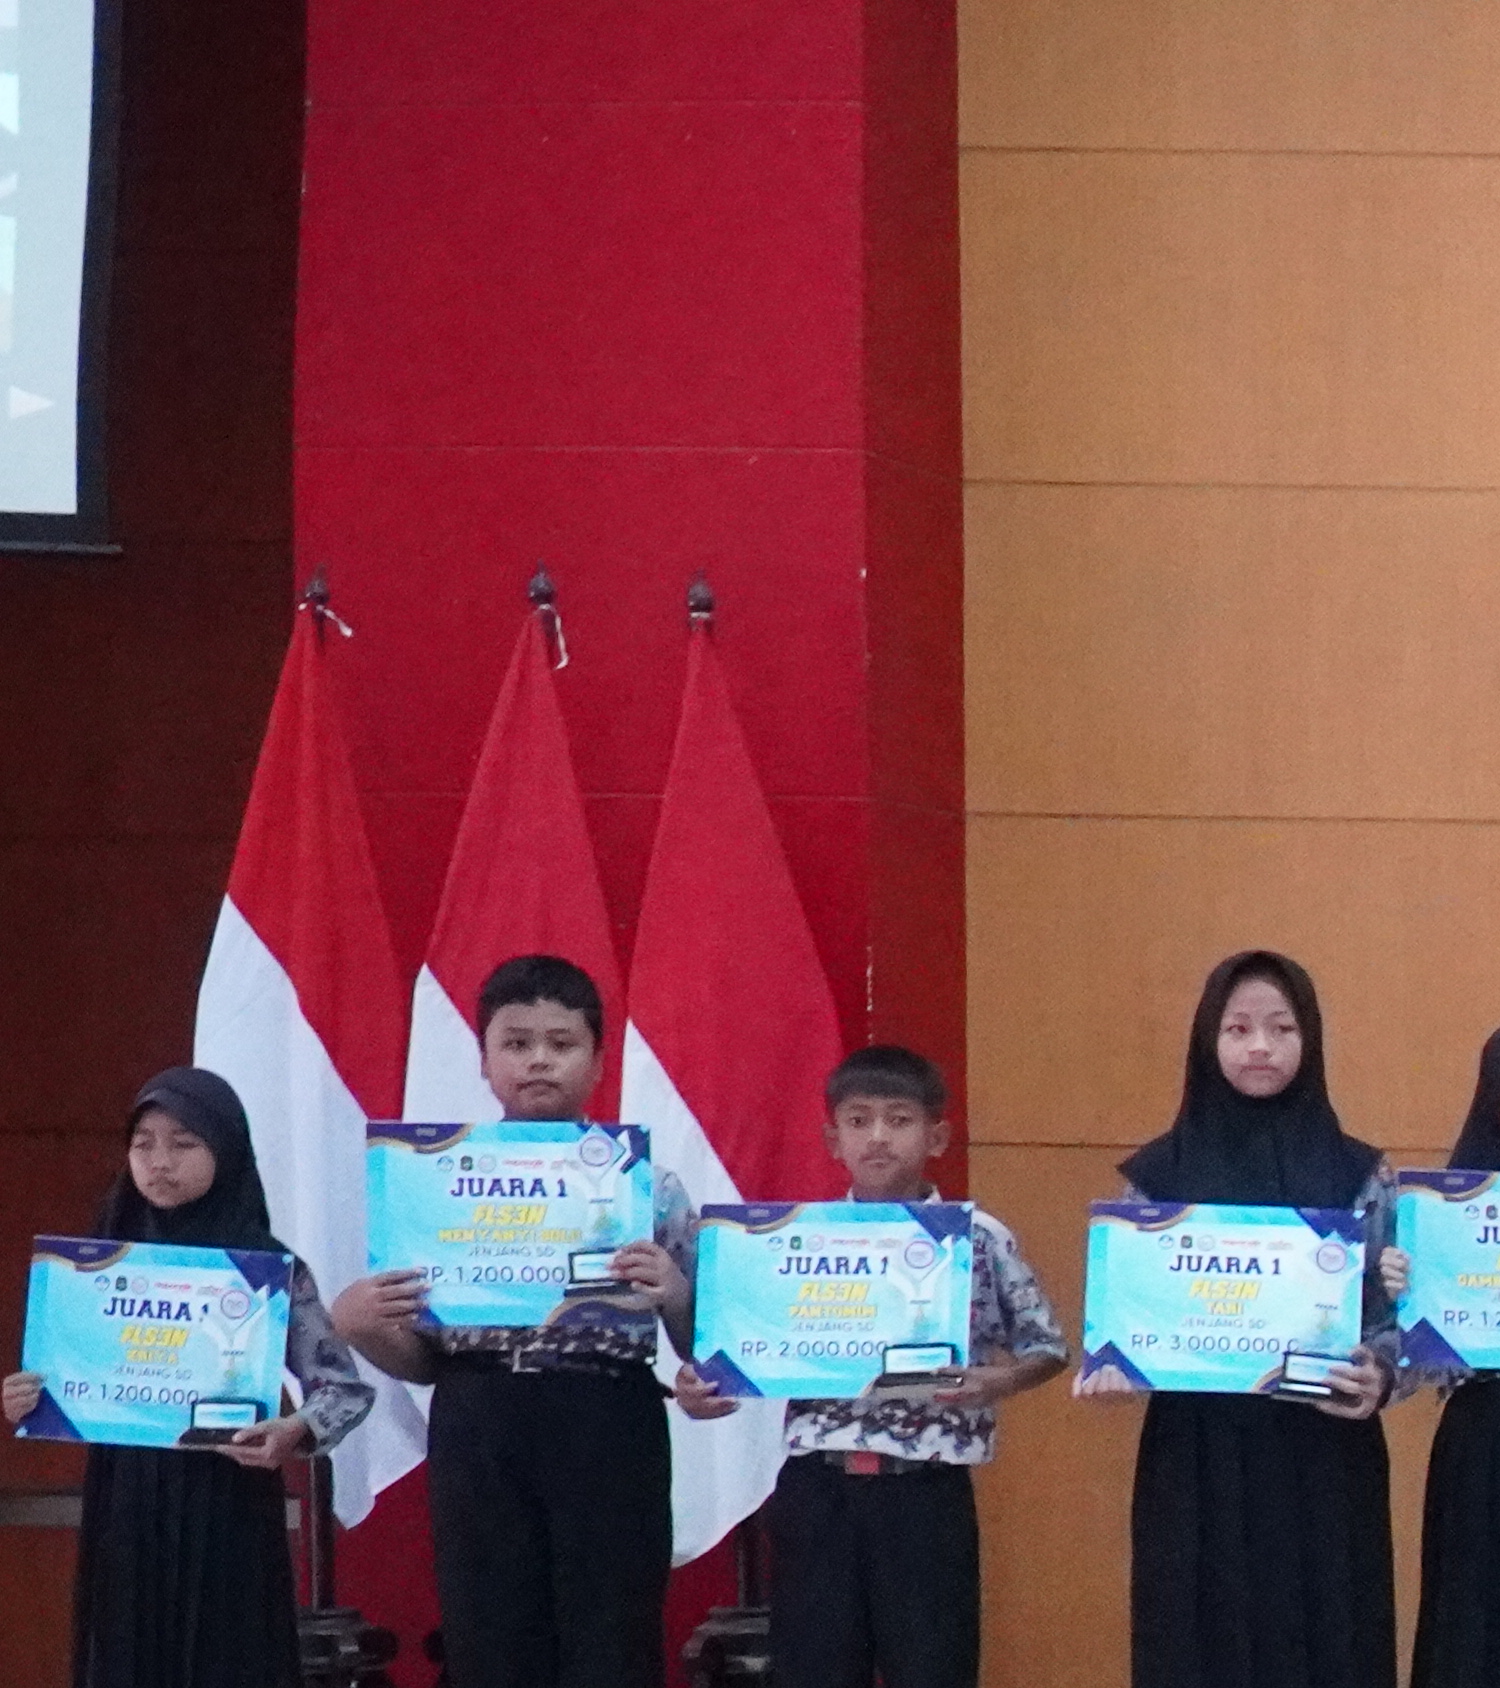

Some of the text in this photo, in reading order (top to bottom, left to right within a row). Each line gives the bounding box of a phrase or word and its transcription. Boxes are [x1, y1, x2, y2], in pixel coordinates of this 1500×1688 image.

[450, 1177, 568, 1198] JUARA 1
[457, 1266, 567, 1283] 1.200.000
[779, 1256, 889, 1275] JUARA 1
[1169, 1255, 1282, 1275] JUARA 1
[103, 1297, 192, 1321] JUARA
[1444, 1310, 1473, 1326] RP.
[741, 1340, 887, 1357] RP. 2.000.000
[1131, 1334, 1160, 1349] RP.
[64, 1381, 200, 1406] RP. 1.200.000
